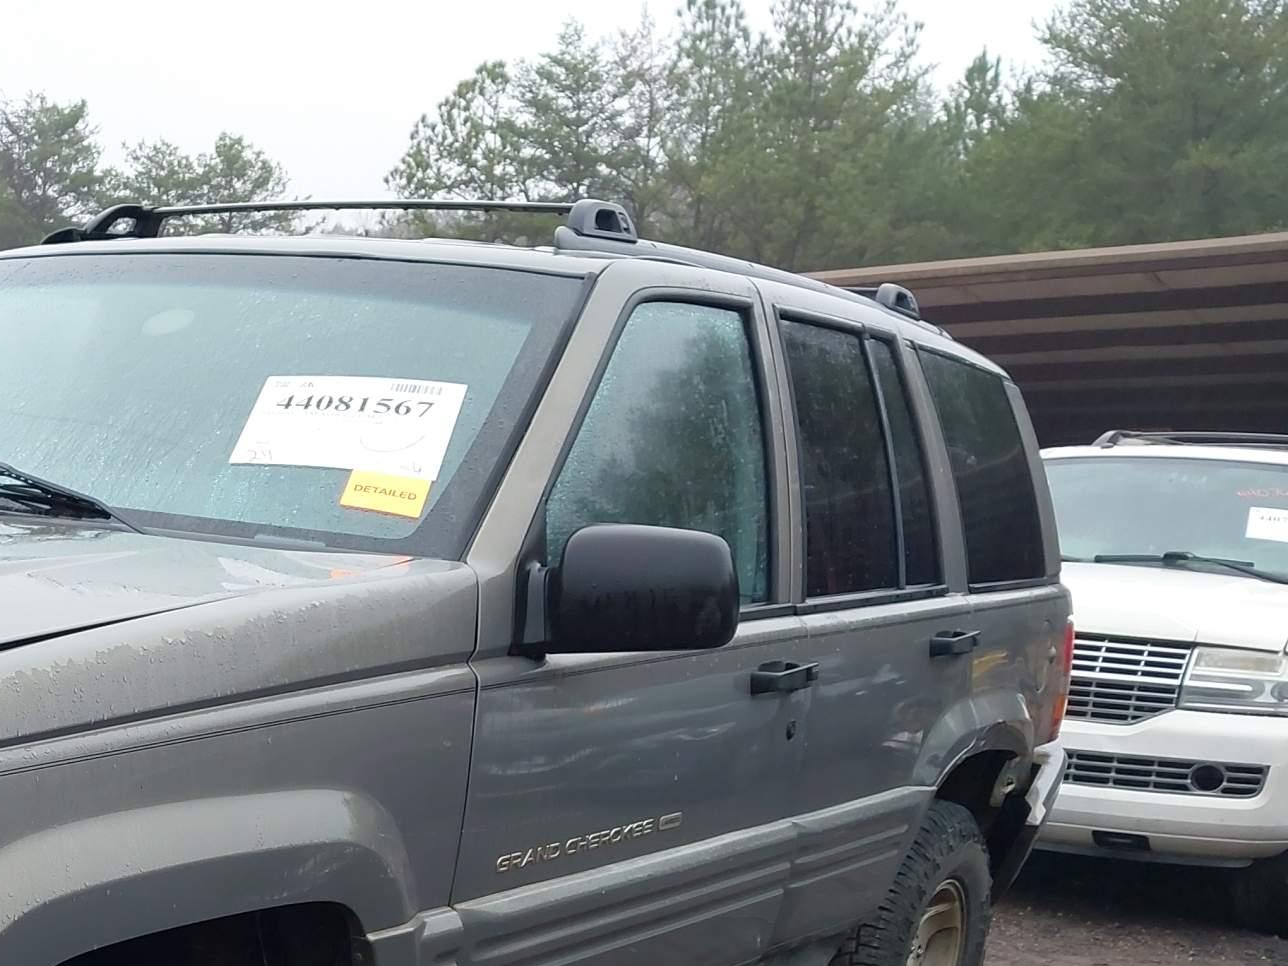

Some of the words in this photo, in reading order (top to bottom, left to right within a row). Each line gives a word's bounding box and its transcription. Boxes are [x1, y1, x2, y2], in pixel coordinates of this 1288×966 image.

[275, 394, 436, 418] 44081567
[353, 483, 417, 502] DETAILED
[496, 842, 561, 873] GRAND
[564, 818, 657, 856] CHEROKEE
